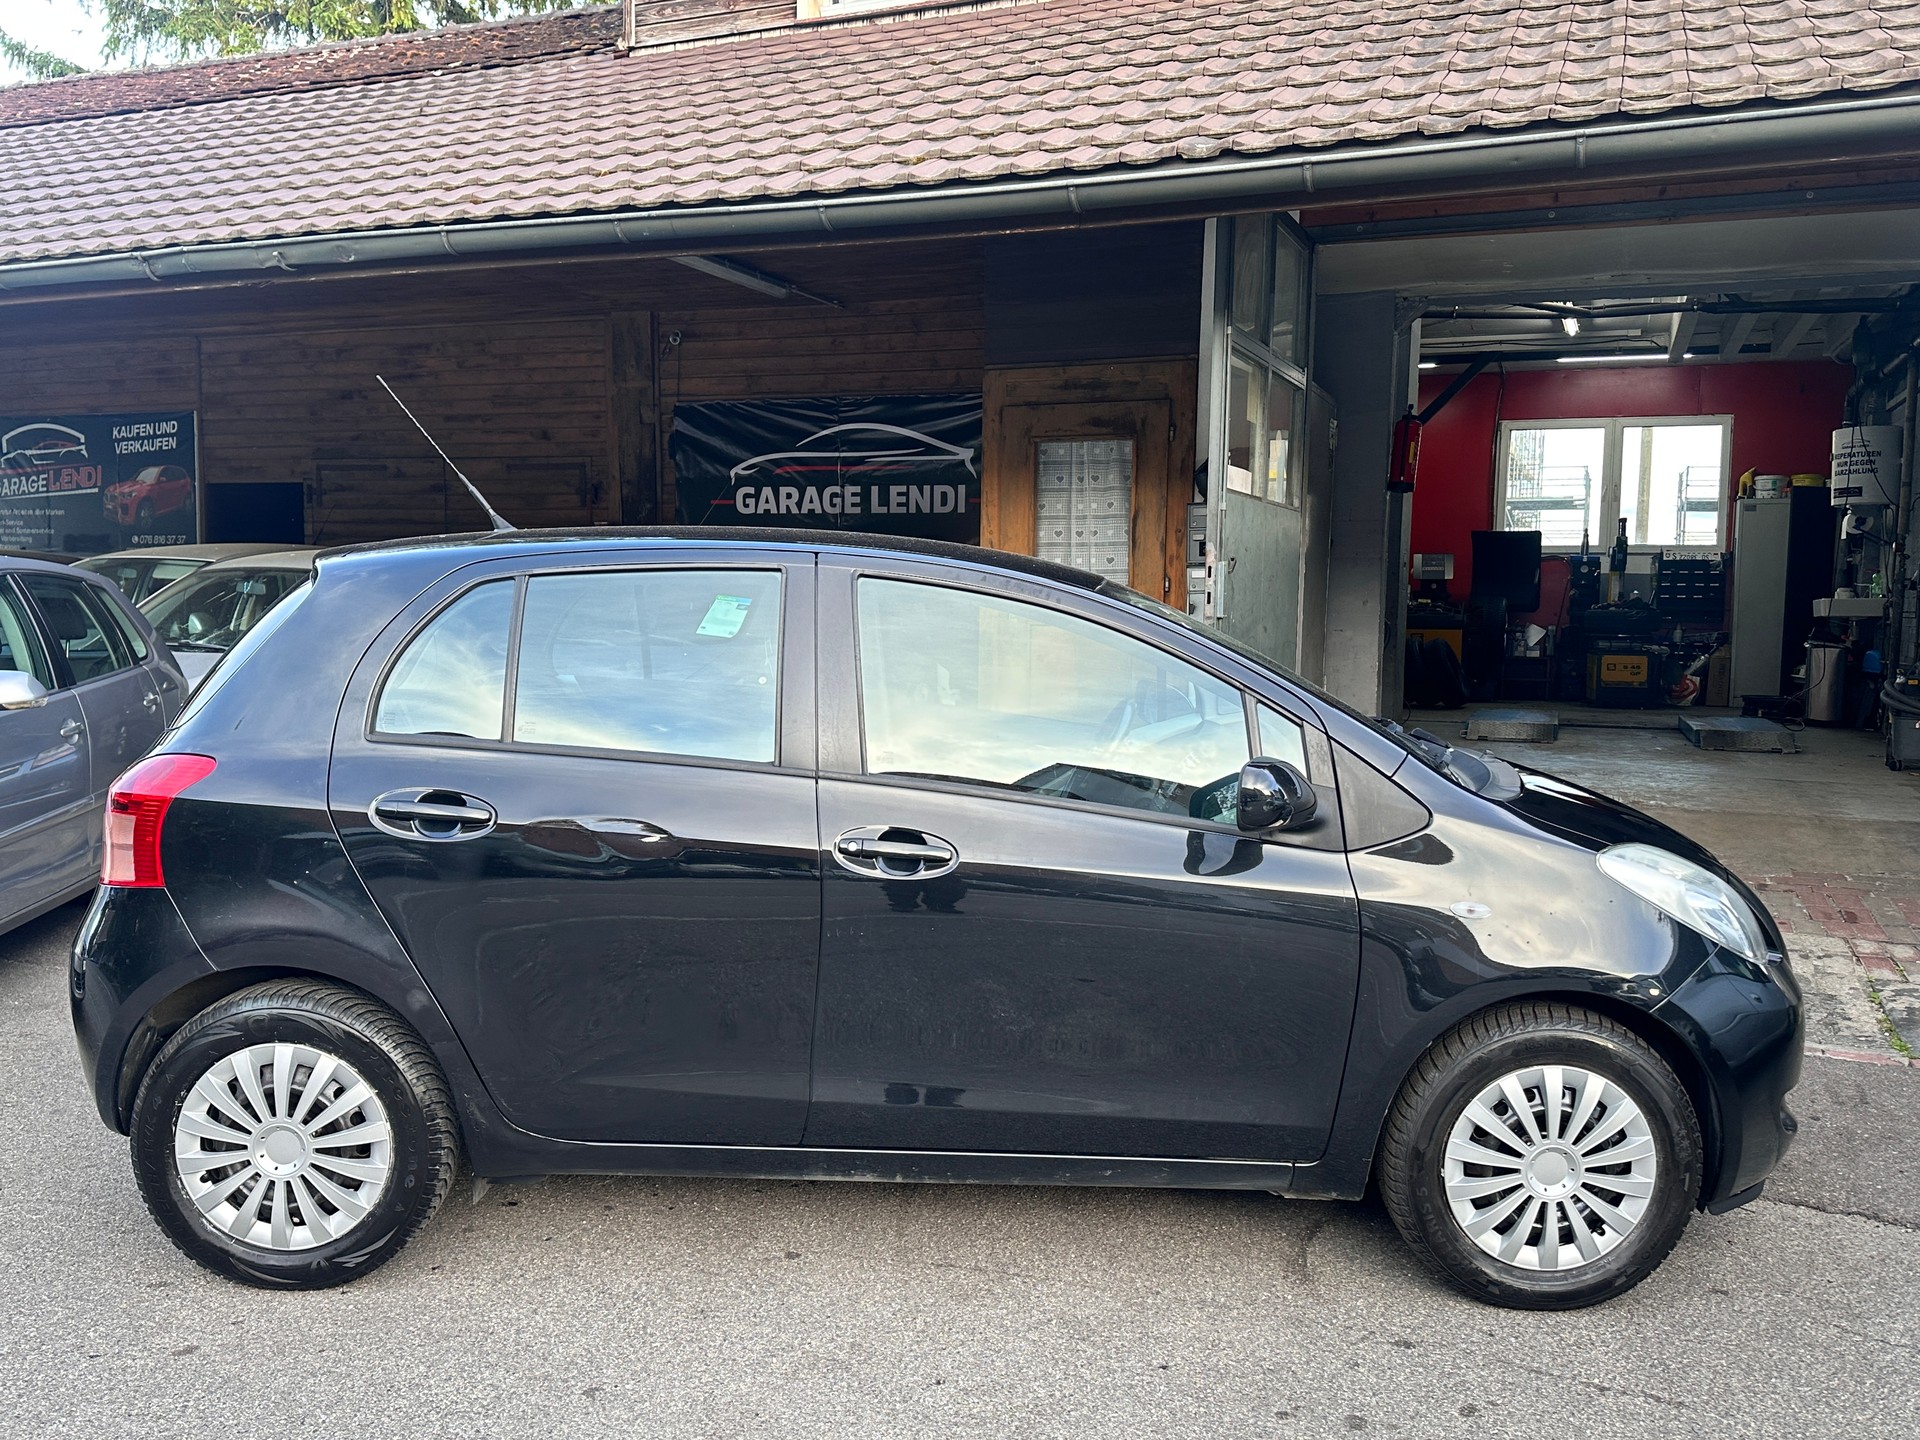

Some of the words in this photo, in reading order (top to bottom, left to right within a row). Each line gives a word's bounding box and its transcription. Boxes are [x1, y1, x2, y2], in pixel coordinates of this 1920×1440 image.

[112, 423, 154, 439] KAUFEN
[155, 421, 178, 435] UND
[114, 436, 177, 454] VERKAUFEN
[1837, 460, 1849, 468] NUR
[1850, 459, 1876, 467] GEGEN
[0, 473, 48, 497] ARAGE
[48, 465, 102, 492] LENDI
[735, 486, 861, 514] GARAGE
[870, 484, 966, 514] LENDI
